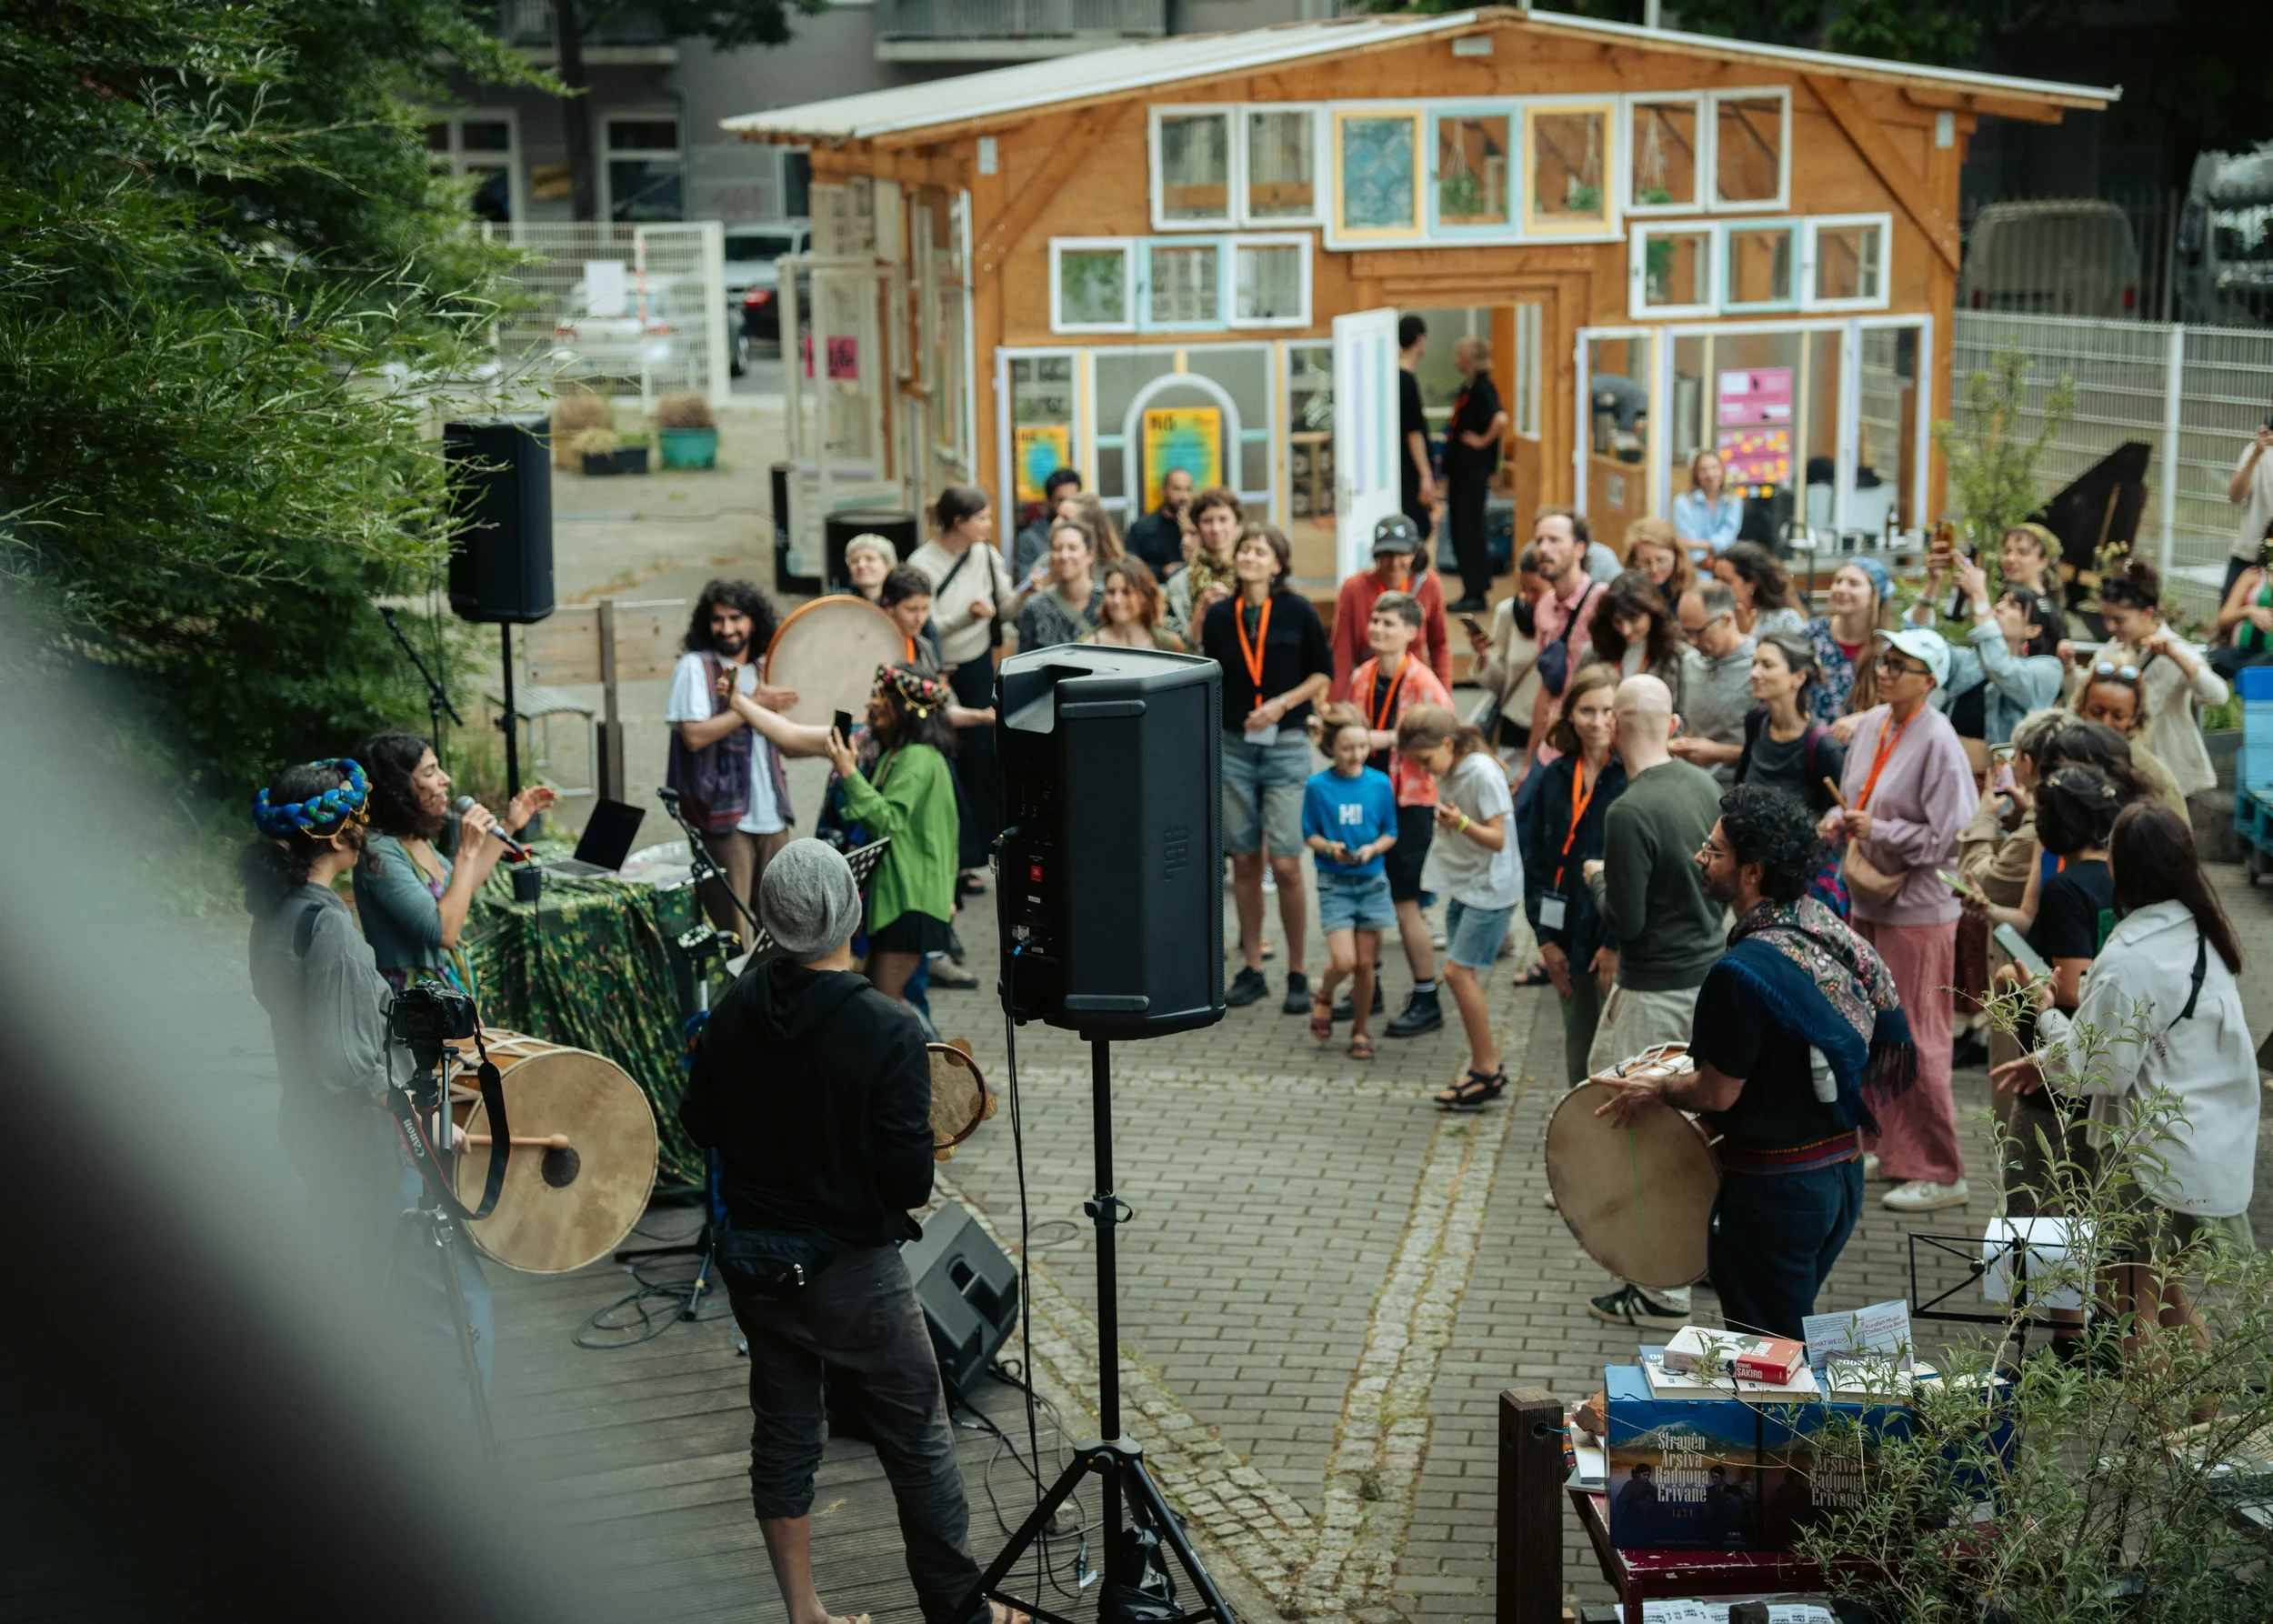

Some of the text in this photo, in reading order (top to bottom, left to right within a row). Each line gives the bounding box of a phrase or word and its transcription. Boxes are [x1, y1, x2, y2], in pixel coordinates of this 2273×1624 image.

[403, 1118, 425, 1158] Canon
[1865, 1319, 1886, 1329] Kurdish
[1886, 1315, 1901, 1324] Music
[1865, 1318, 1908, 1335] Collective Berlin
[1809, 1339, 1827, 1348] WHAT
[1737, 1368, 1763, 1379] ŞAKIRO
[1657, 1431, 1706, 1450] Stranên
[1655, 1466, 1708, 1487] Radyoya
[1657, 1484, 1707, 1502] Erîvanê
